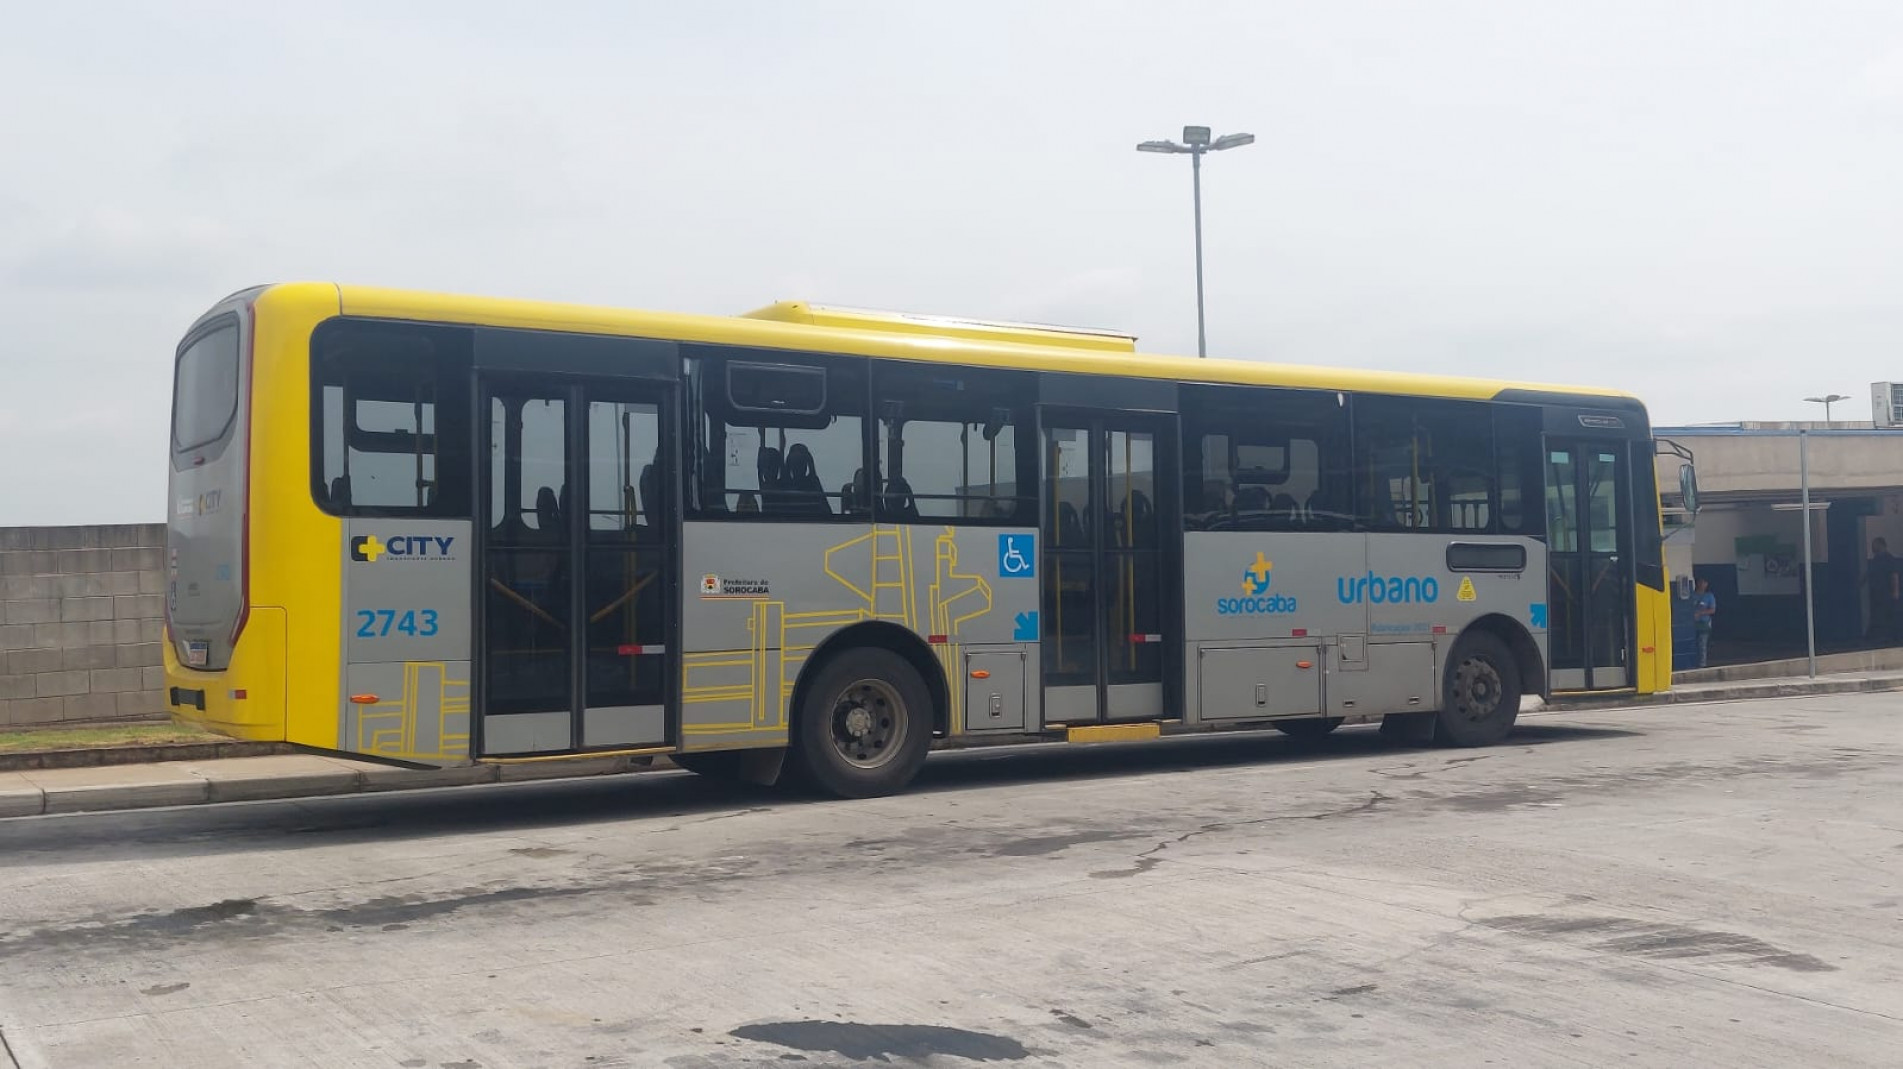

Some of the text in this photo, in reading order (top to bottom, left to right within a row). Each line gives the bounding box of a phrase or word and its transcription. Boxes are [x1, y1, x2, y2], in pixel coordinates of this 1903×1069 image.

[386, 536, 454, 555] CITY
[723, 586, 769, 594] SOROCABA
[1338, 571, 1438, 604] urbano
[1217, 594, 1297, 614] sorocaba
[357, 610, 439, 638] 2743
